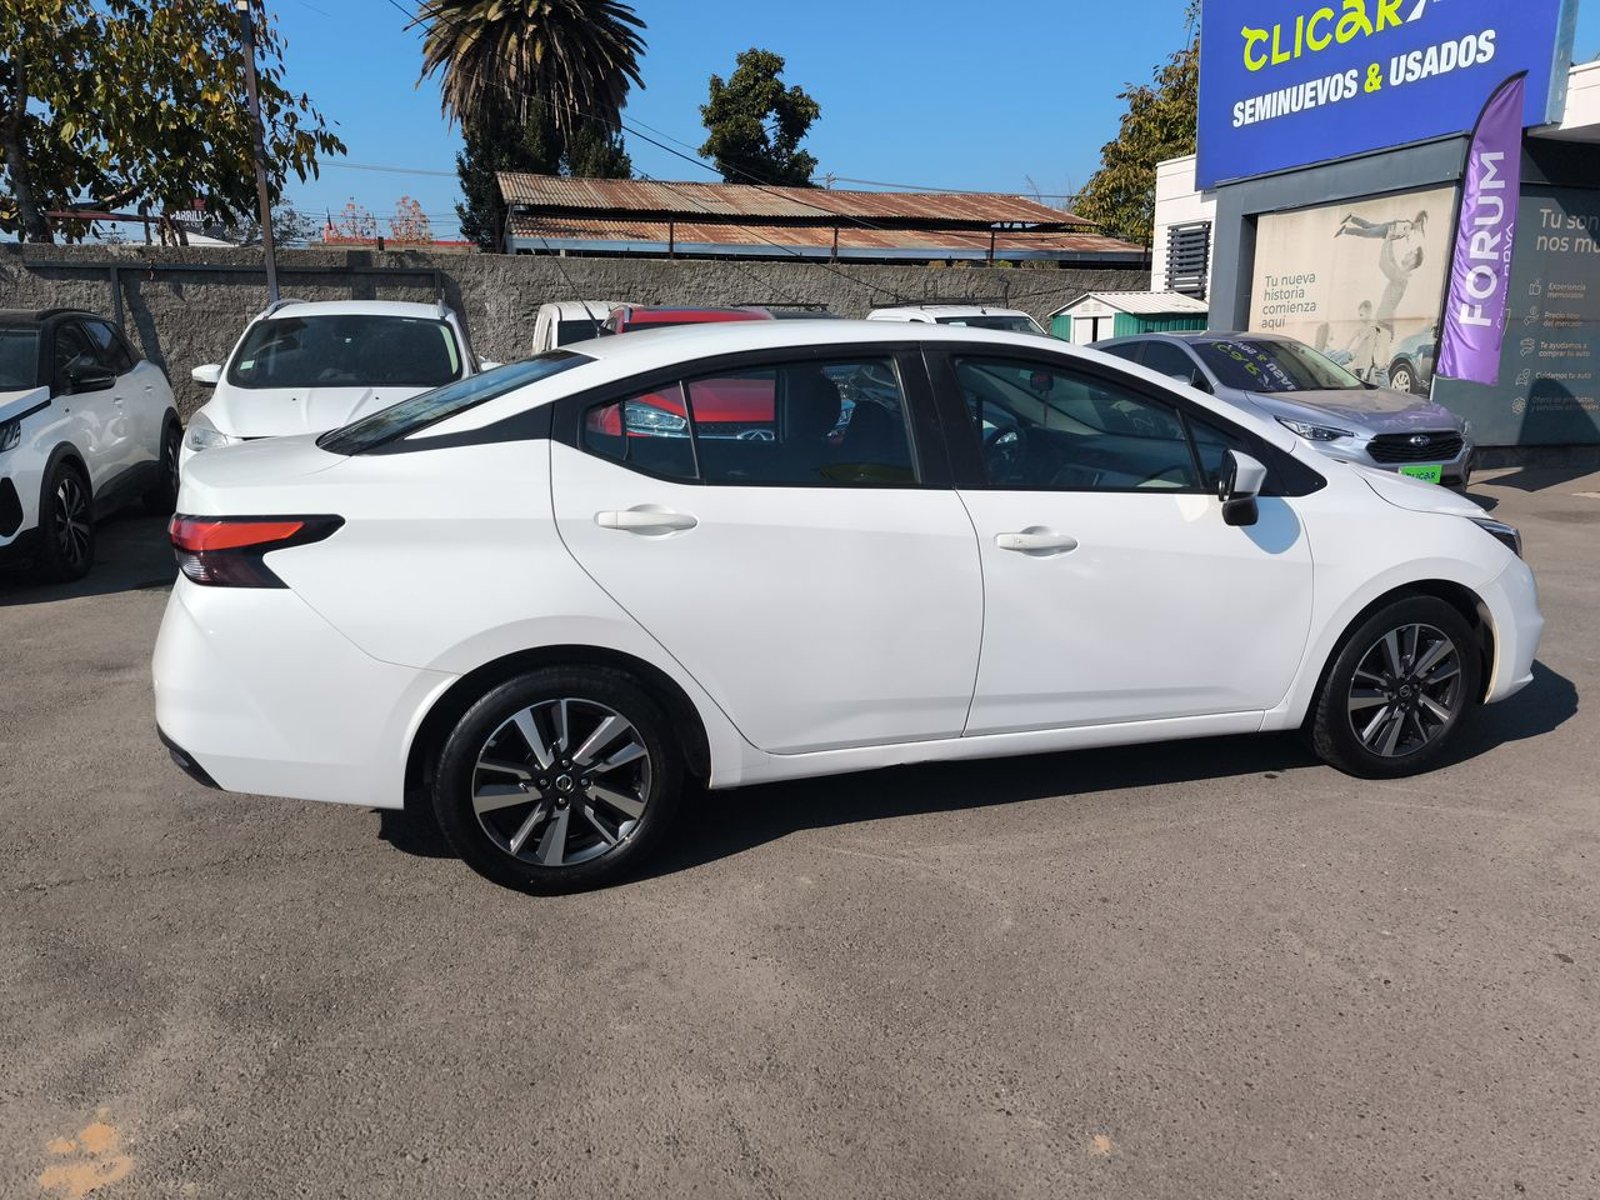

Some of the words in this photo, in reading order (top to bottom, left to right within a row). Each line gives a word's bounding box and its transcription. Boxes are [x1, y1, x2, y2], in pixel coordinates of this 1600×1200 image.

[1232, 69, 1359, 128] SEMINUEVOS
[1364, 63, 1383, 93] &
[1389, 29, 1496, 87] USADOS
[1540, 208, 1562, 229] Tu
[1458, 151, 1506, 327] FORUM
[1536, 235, 1570, 252] nos
[1265, 275, 1279, 288] Tu
[1281, 273, 1316, 286] nueva
[1263, 286, 1305, 301] historia
[1262, 300, 1317, 315] comienza
